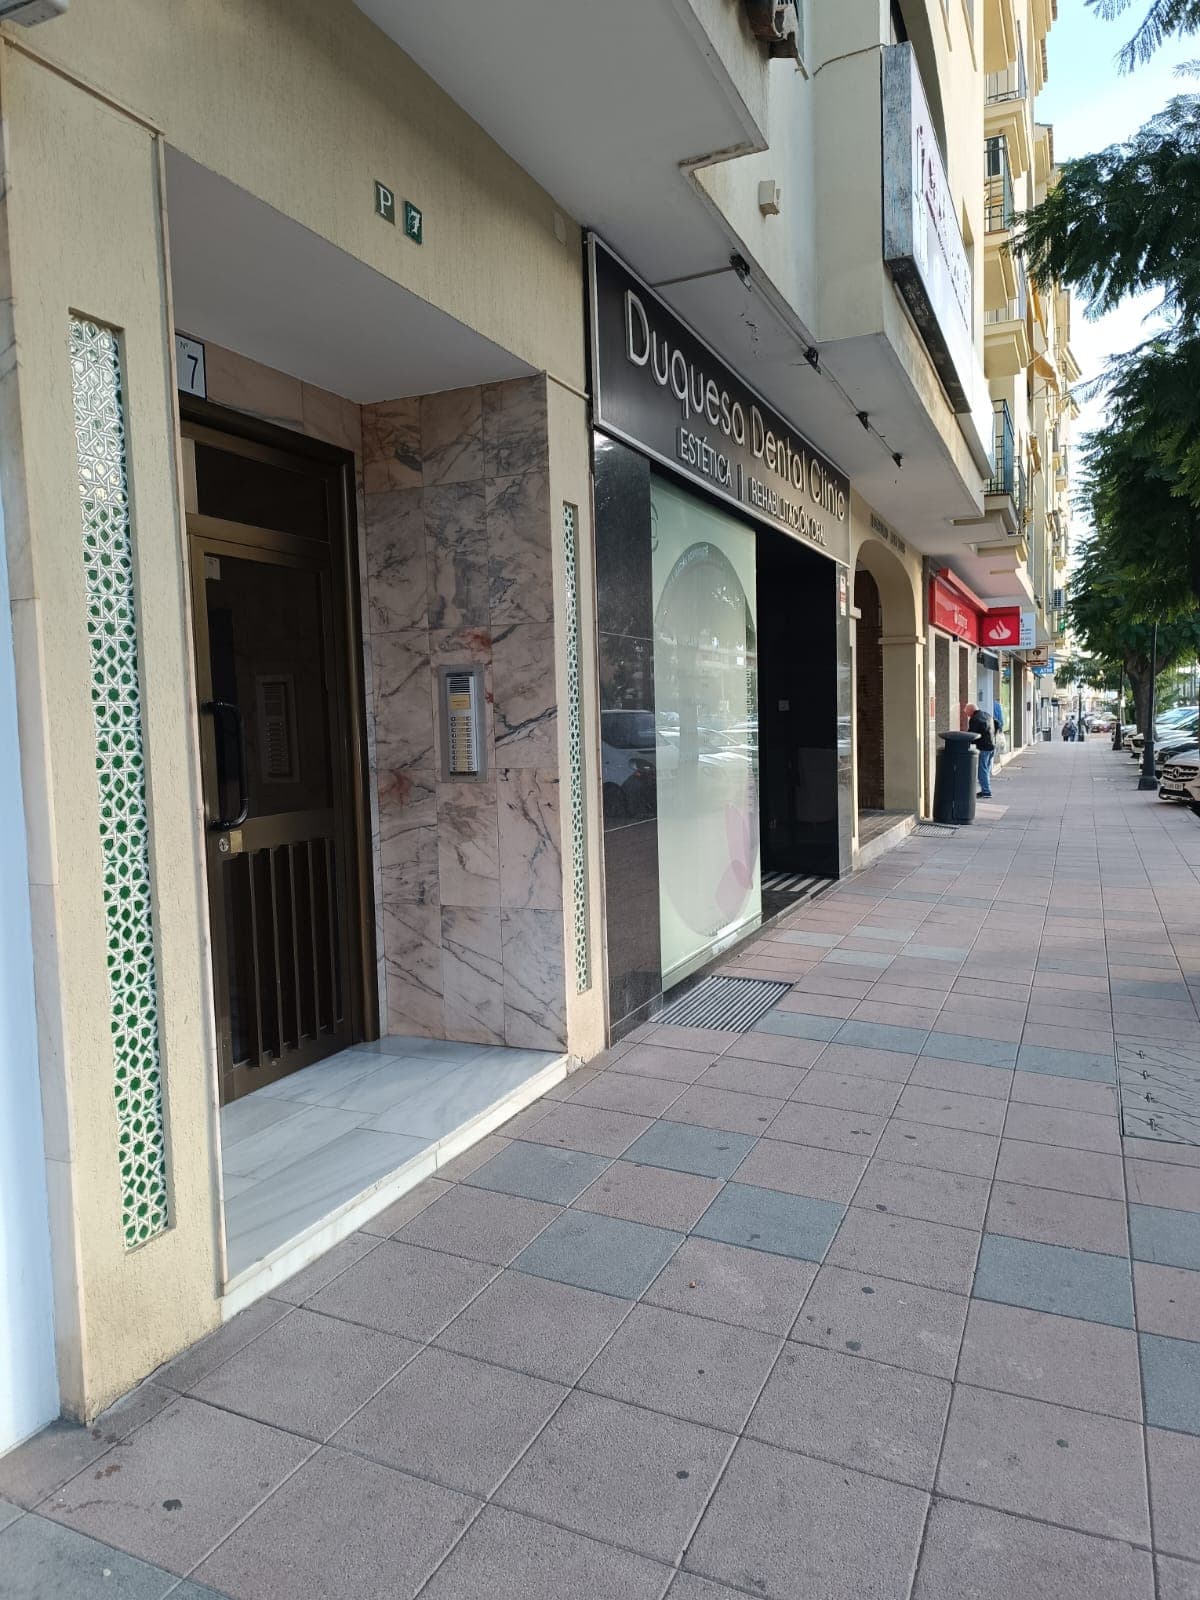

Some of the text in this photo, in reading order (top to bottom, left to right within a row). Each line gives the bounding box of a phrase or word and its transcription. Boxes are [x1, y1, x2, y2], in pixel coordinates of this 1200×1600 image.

[377, 184, 392, 216] P
[187, 354, 199, 389] 7
[625, 289, 845, 521] Duquesa Dental Clinic
[679, 427, 732, 488] ESTÉTICA
[751, 476, 810, 536] REHABILITACIÓN
